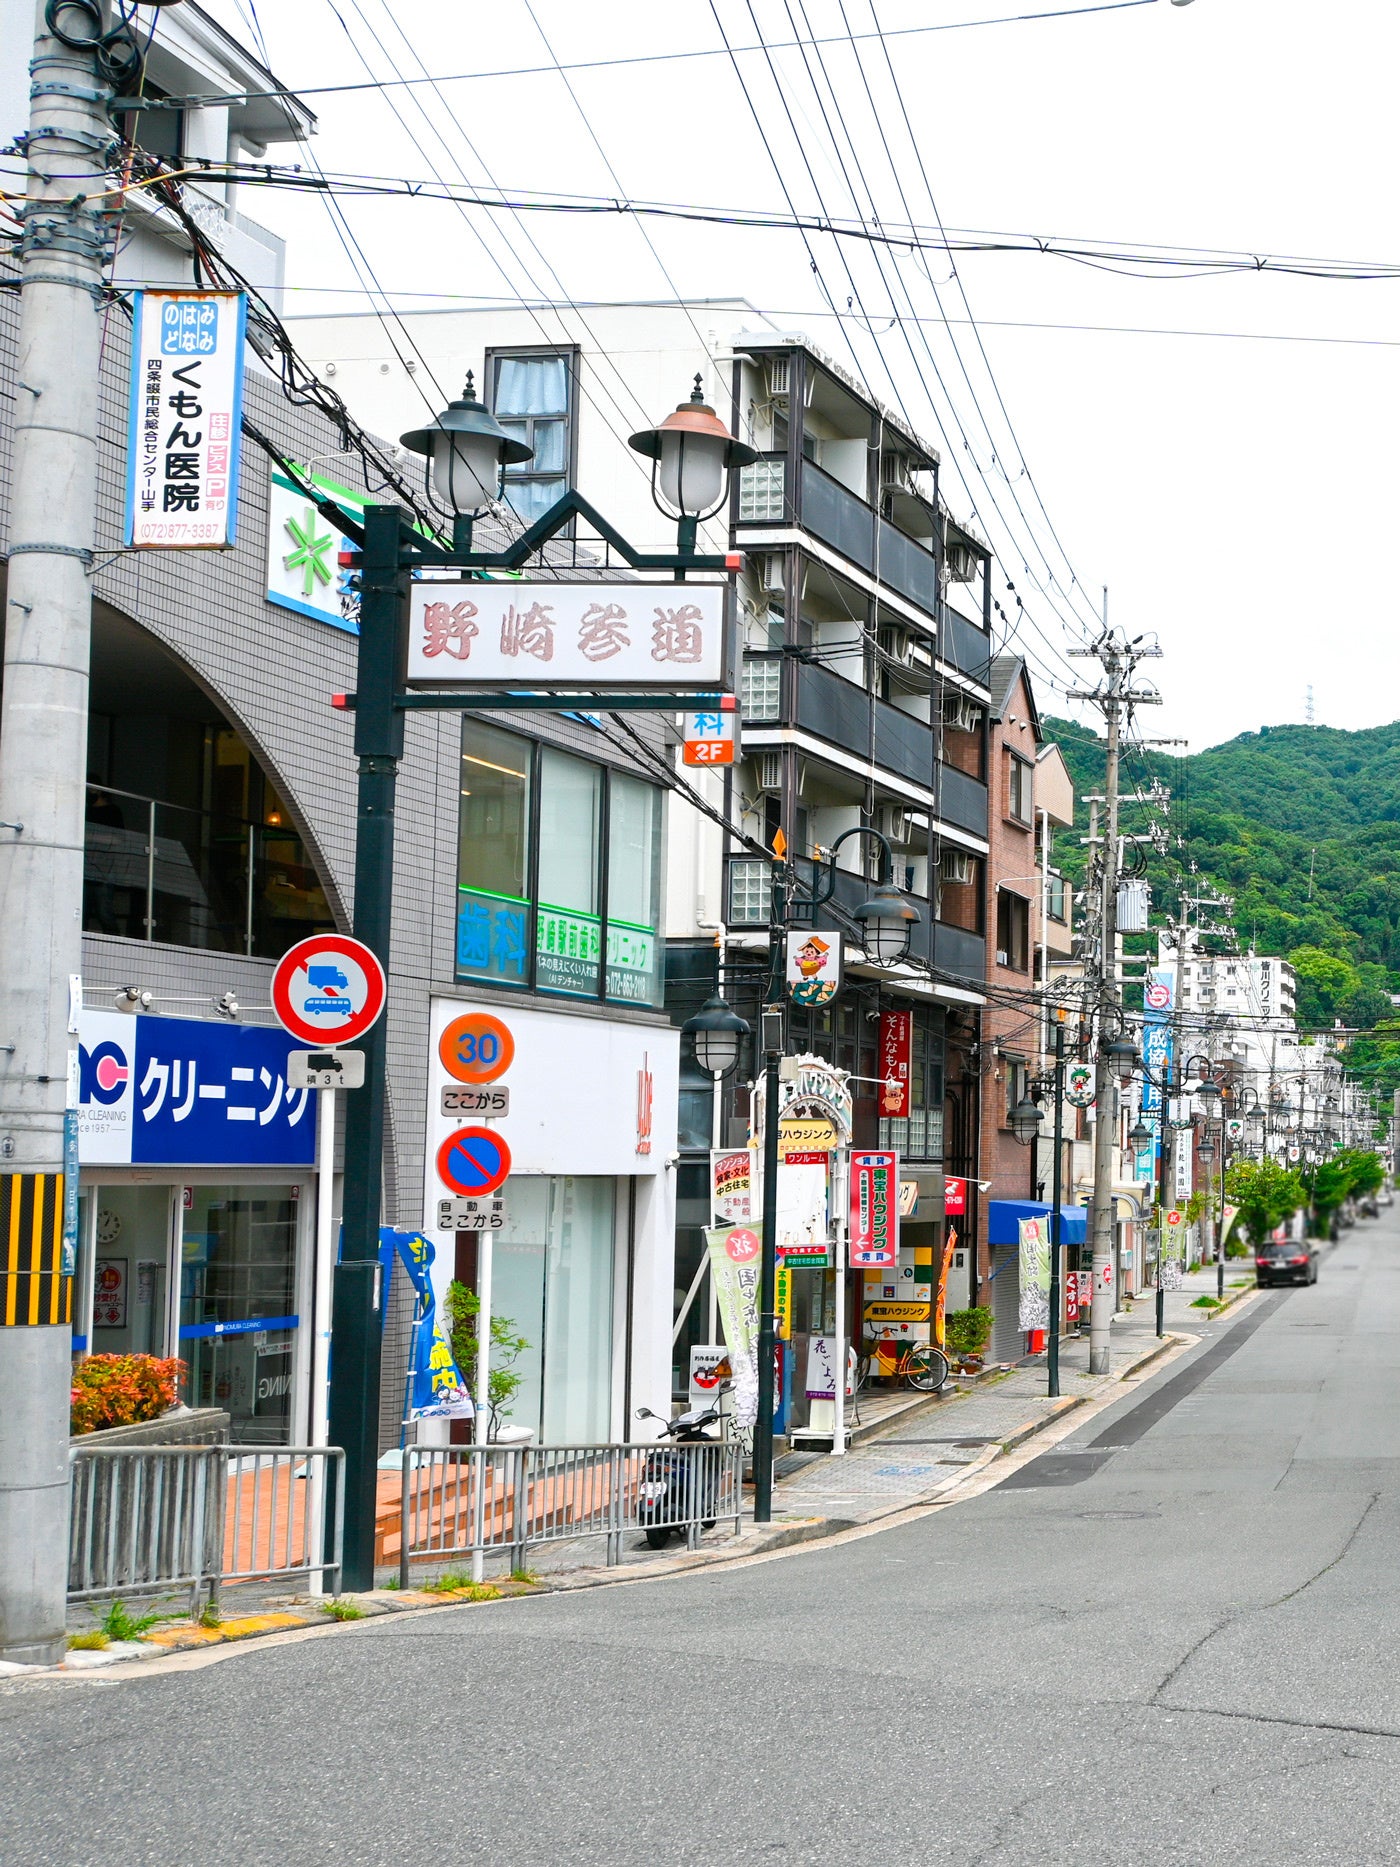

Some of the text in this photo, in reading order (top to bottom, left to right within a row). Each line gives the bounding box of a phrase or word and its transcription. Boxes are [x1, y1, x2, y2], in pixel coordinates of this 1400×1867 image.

[162, 360, 203, 513] くもん医院
[207, 479, 224, 496] P
[140, 523, 219, 539] (072)877-3387
[695, 743, 723, 760] 2F
[458, 902, 527, 975] 歯科
[537, 915, 647, 967] 野崎駅前歯科リニック
[458, 1033, 498, 1064] 30
[444, 1093, 506, 1110] ここから
[88, 1110, 127, 1121] CLEANING
[92, 1124, 111, 1133] 1957
[716, 1155, 750, 1171] マンション
[788, 1155, 825, 1163] ワンルーム
[716, 1179, 749, 1196] 中古住宅
[441, 1201, 503, 1212] 自動車
[873, 1168, 888, 1250] 東宝ハウジング
[440, 1215, 503, 1228] ここから
[1066, 1275, 1077, 1317] くすり
[872, 1307, 925, 1316] 東宝ハウジング
